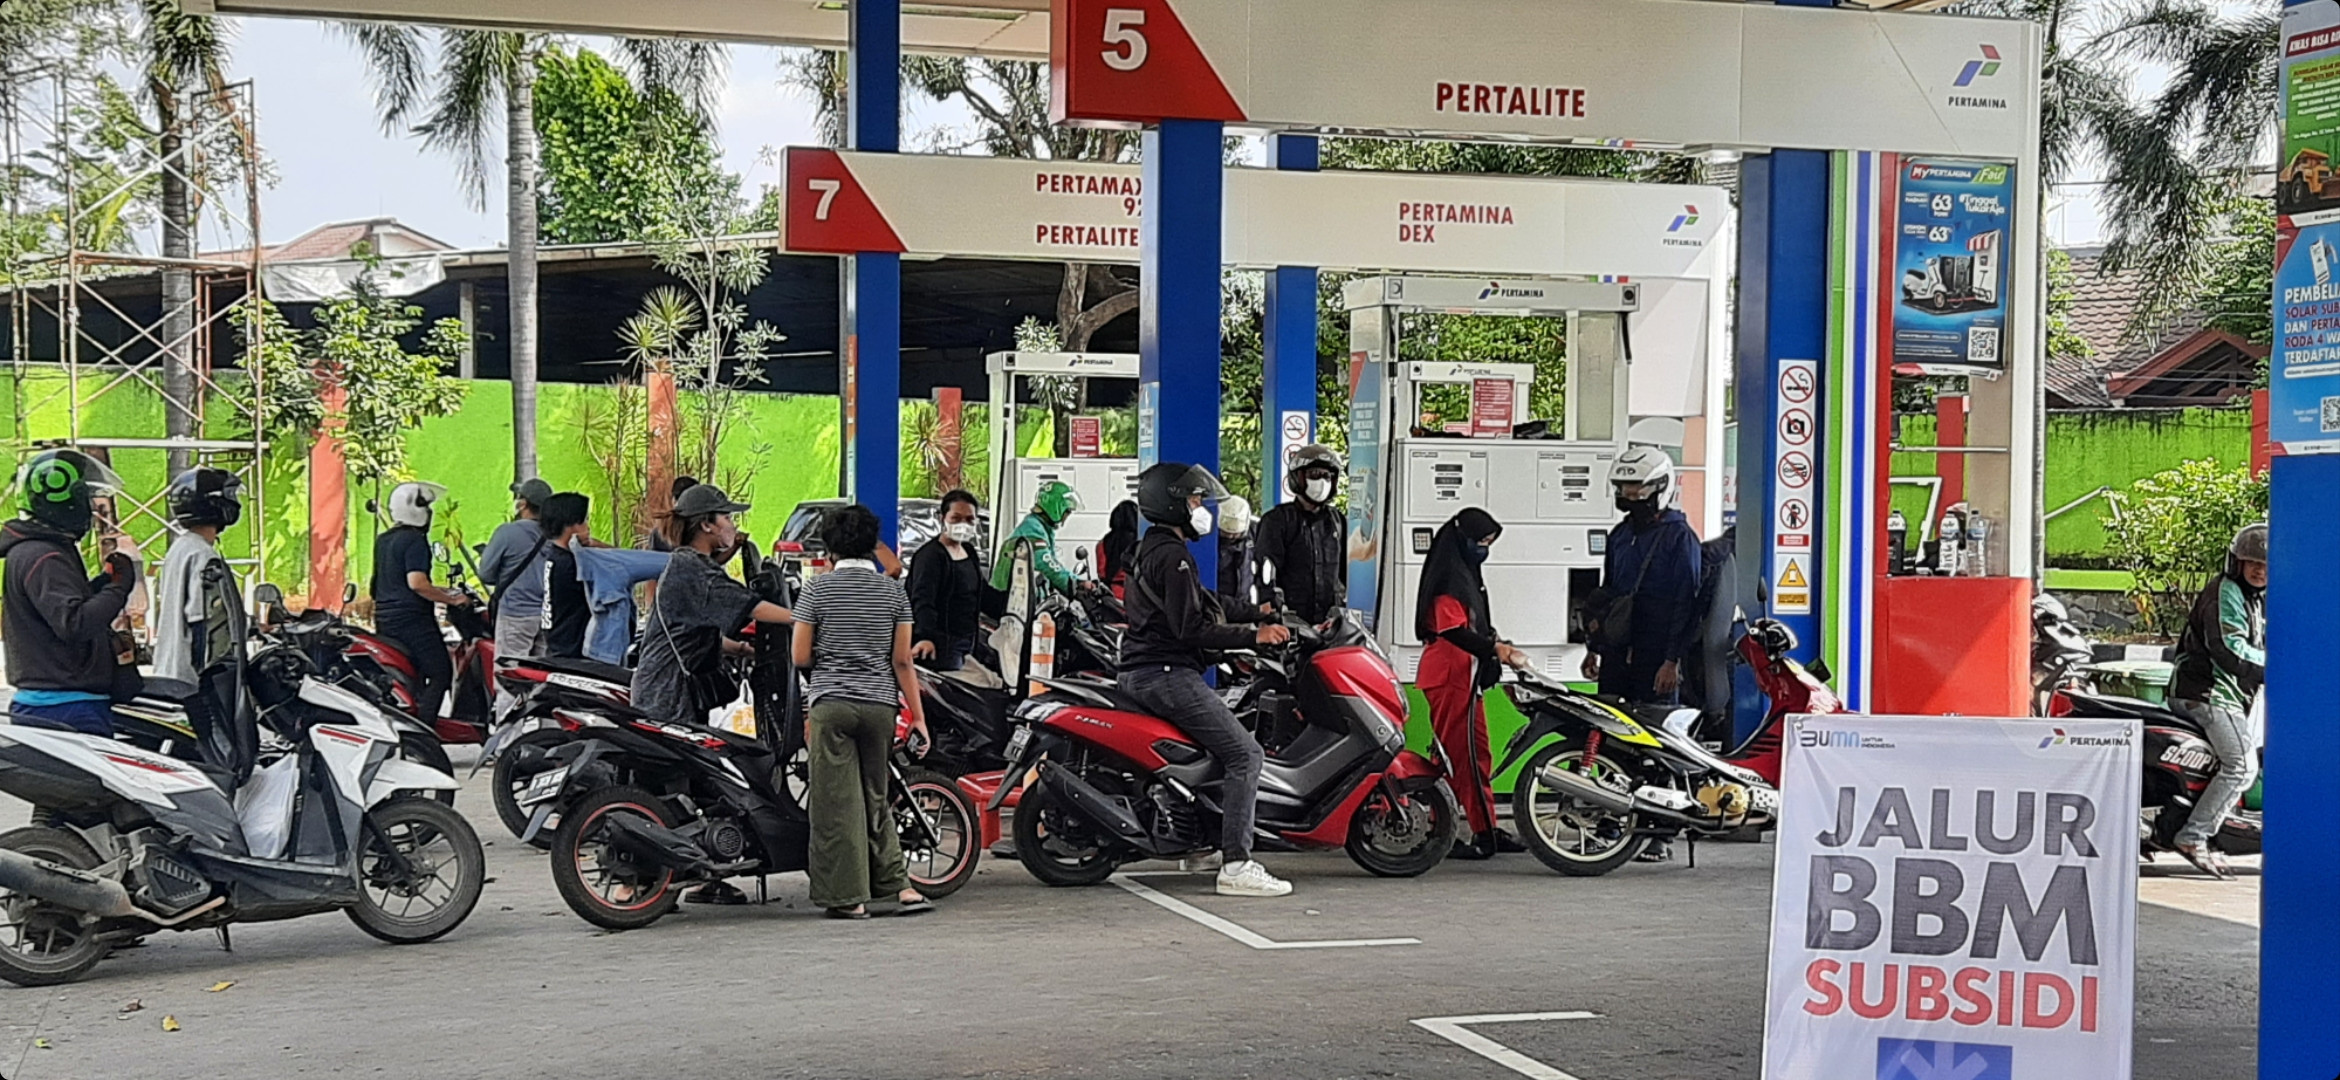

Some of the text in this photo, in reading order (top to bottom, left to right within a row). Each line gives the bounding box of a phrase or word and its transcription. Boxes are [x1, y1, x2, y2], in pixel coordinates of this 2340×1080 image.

[1101, 8, 1148, 71] 5
[1437, 82, 1585, 117] PERTALITE
[1948, 96, 2007, 109] PERTAMINA
[1980, 167, 2004, 182] Fair
[808, 179, 841, 221] 7
[1124, 197, 1142, 216] 9
[1932, 194, 1952, 211] 63
[1400, 202, 1513, 225] PERTAMINA
[1037, 225, 1139, 246] PERTALITE
[1400, 224, 1435, 243] DEX
[1663, 238, 1702, 247] PERTAMINA
[1501, 288, 1544, 298] PERTAMINA
[2285, 304, 2317, 319] SOLAR
[2284, 320, 2307, 334] DAN
[2284, 335, 2313, 348] RODA
[2317, 334, 2323, 345] 4
[2070, 736, 2132, 747] PERTAMINA
[1814, 786, 2100, 858] JALUR
[1804, 854, 2099, 966] BBM
[1801, 958, 2098, 1033] SUBSIDI
